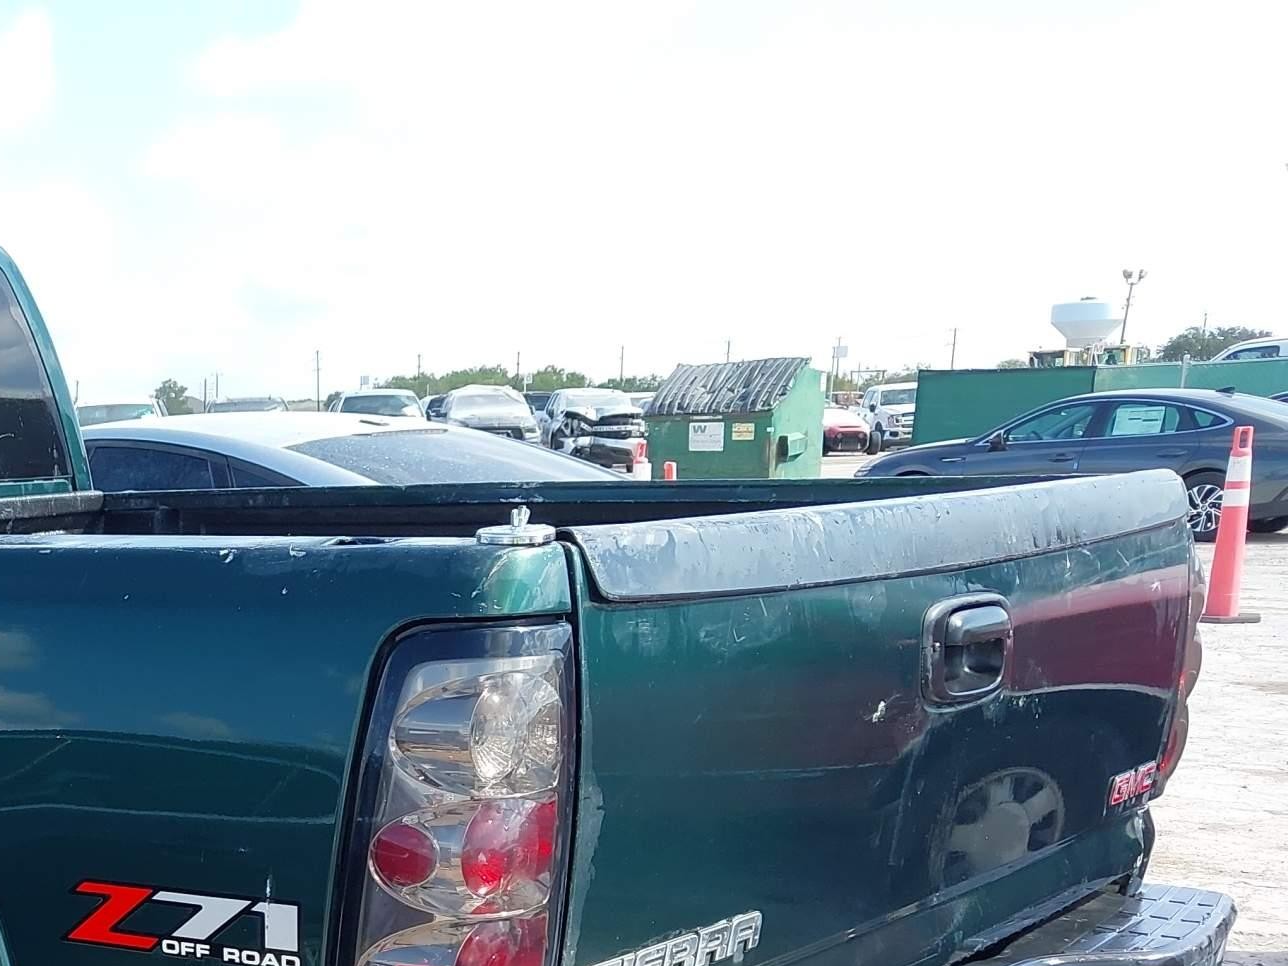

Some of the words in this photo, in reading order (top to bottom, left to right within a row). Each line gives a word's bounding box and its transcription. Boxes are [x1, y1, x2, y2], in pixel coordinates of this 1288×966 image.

[1110, 761, 1157, 805] GMC
[66, 880, 300, 954] Z71
[161, 938, 211, 959] OFF
